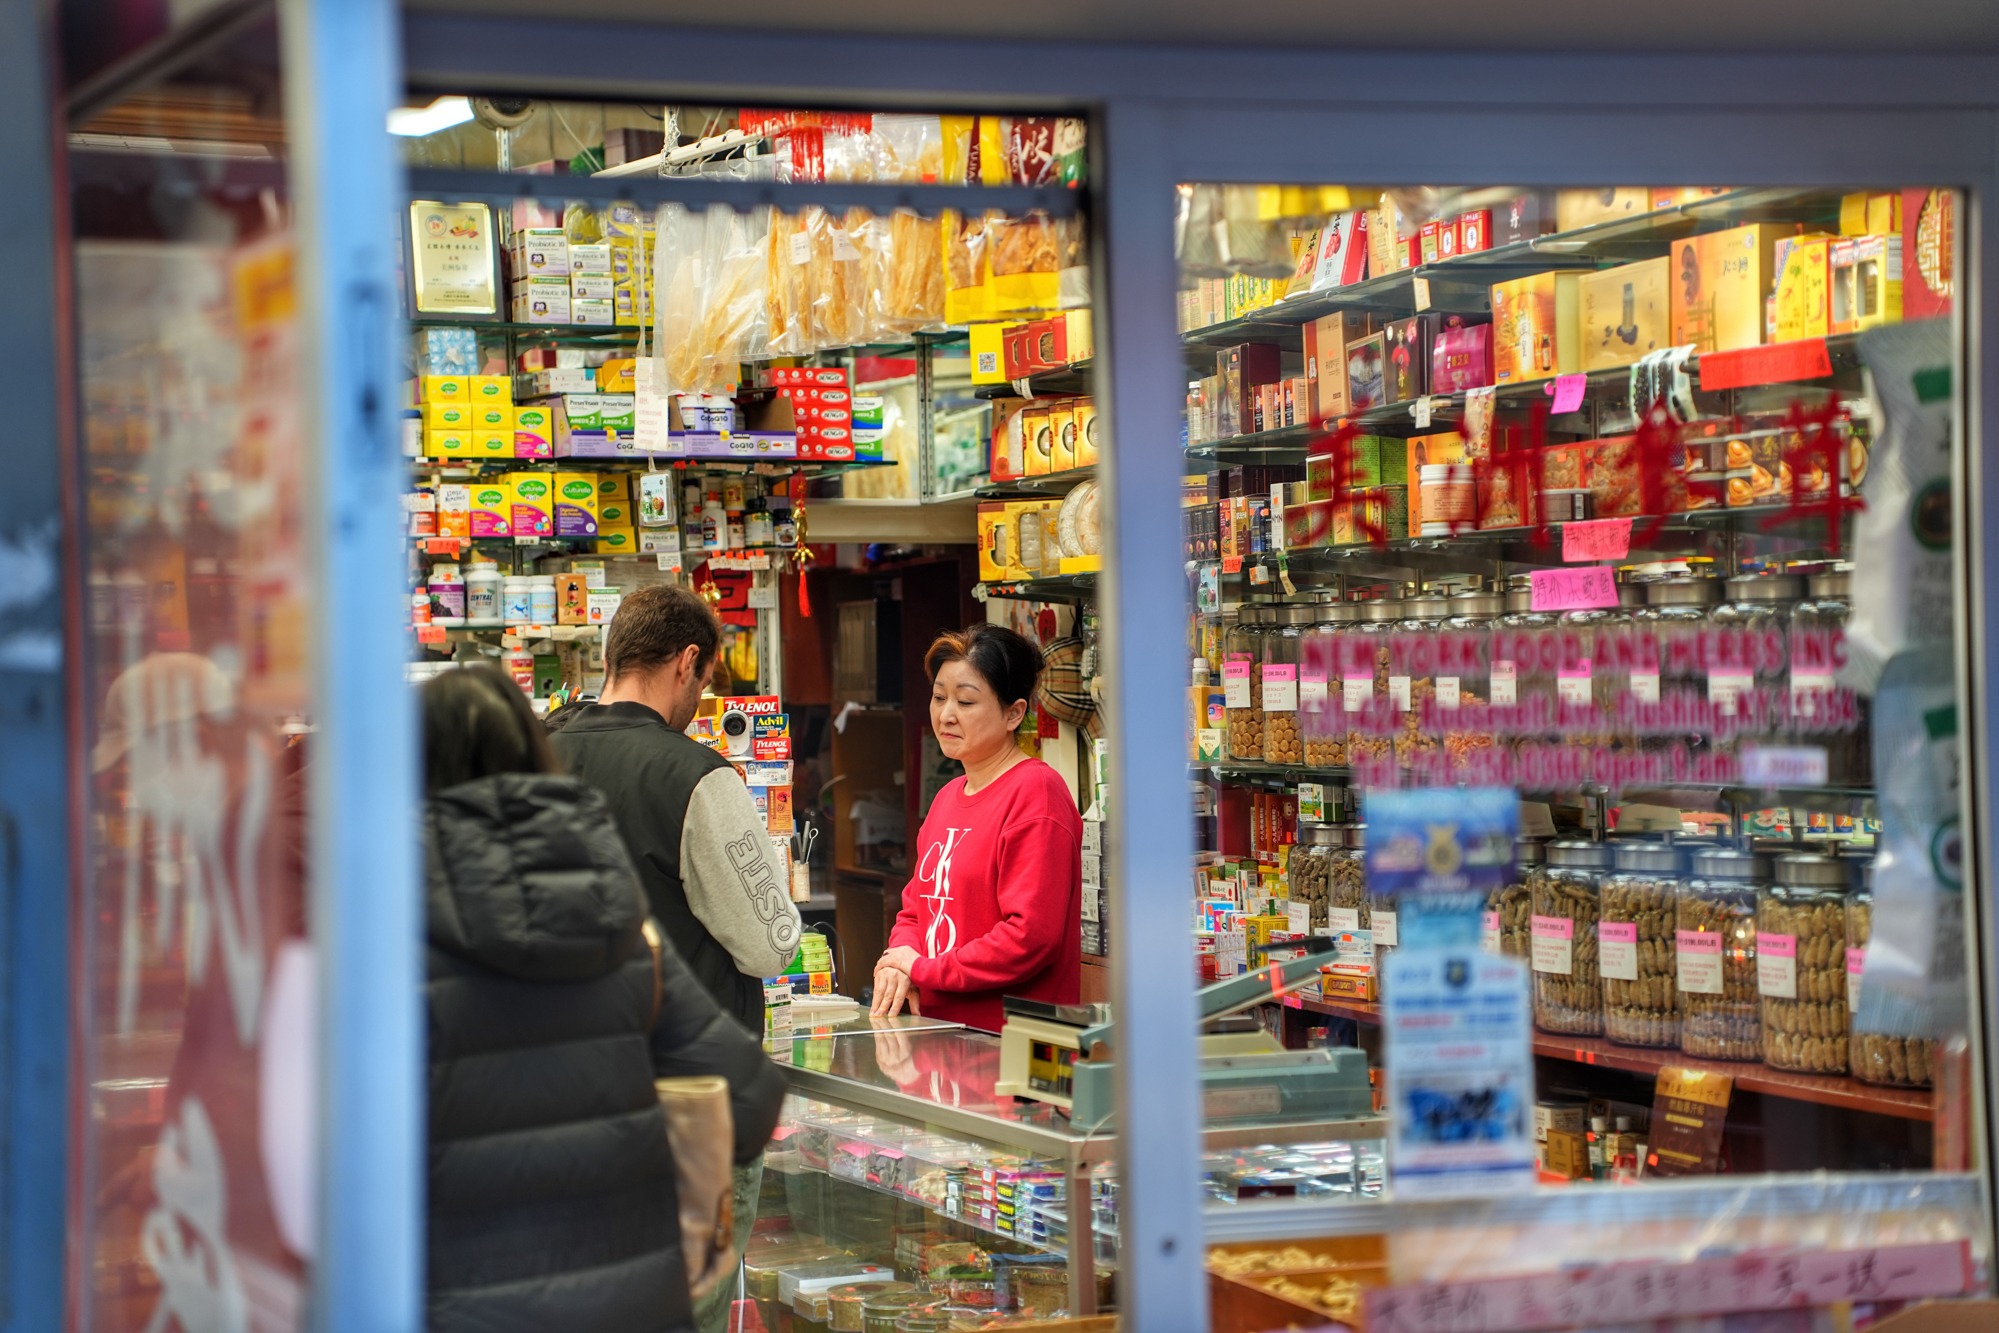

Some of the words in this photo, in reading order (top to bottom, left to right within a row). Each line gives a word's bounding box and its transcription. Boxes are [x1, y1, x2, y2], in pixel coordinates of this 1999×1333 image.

[1303, 634, 1375, 671] NEW
[1390, 634, 1482, 671] YORK
[1491, 632, 1583, 672] FOOD
[1594, 631, 1659, 670] AND
[1667, 630, 1785, 672] HERBS
[1790, 629, 1849, 669] INC
[725, 701, 777, 712] TYLENOL
[1419, 693, 1551, 732] Roosevelt
[756, 716, 784, 726] Advil
